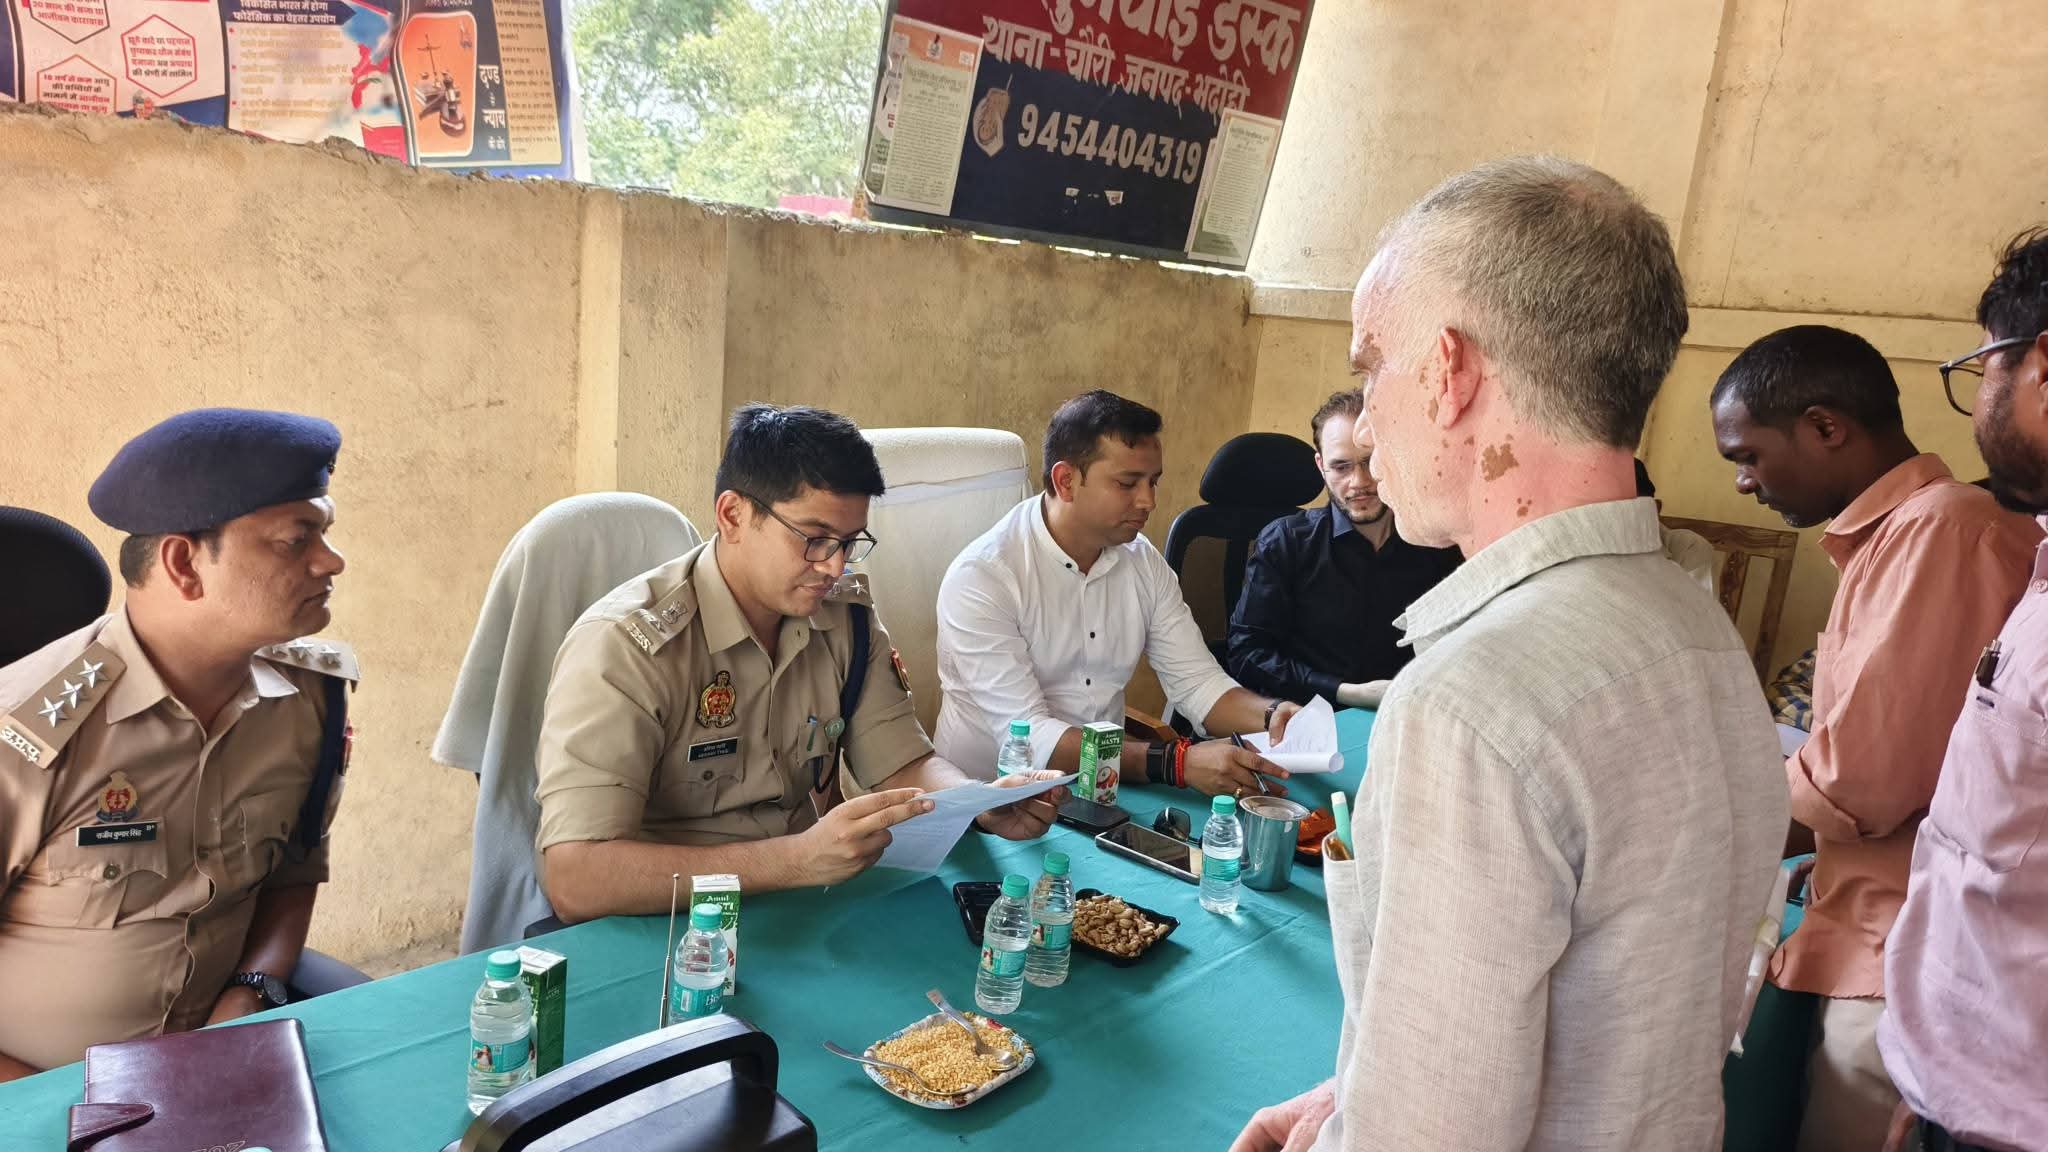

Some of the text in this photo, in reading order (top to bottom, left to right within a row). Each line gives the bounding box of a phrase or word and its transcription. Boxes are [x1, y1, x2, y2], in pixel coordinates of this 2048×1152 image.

[279, 0, 301, 10] भारत
[310, 1, 328, 11] होगा
[273, 13, 285, 22] का
[478, 65, 500, 88] दण्ड
[482, 109, 506, 129] न्याय
[1018, 104, 1202, 184] 9454404319
